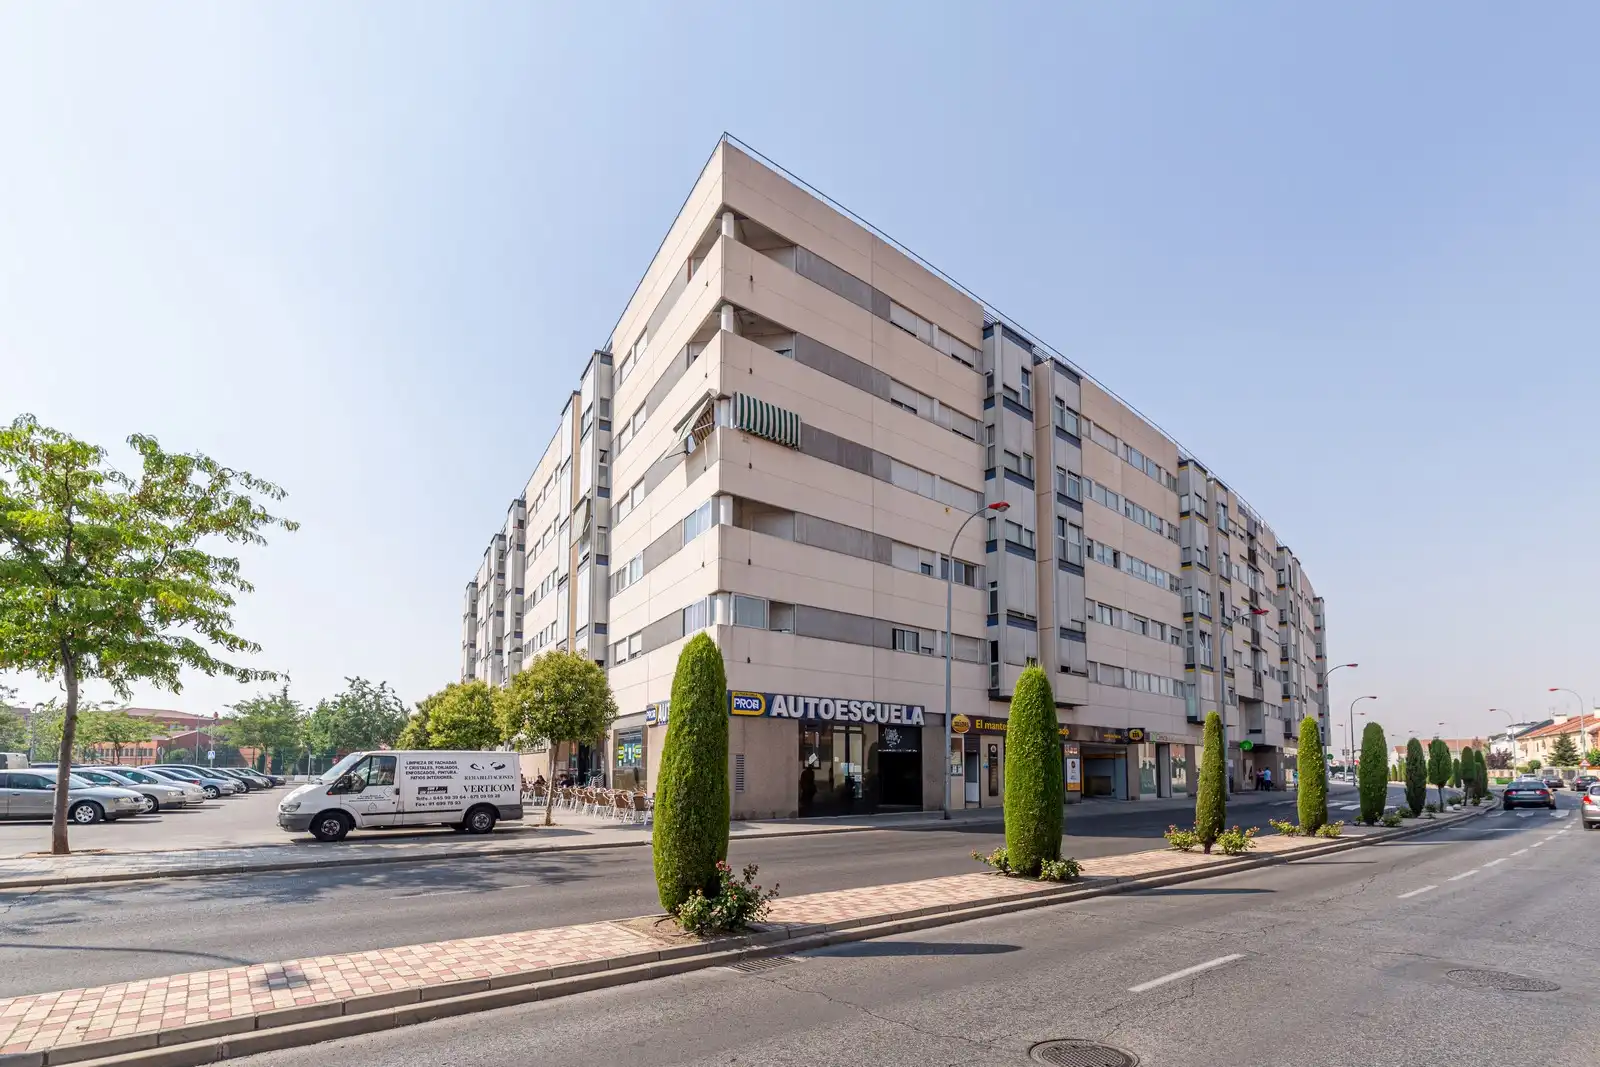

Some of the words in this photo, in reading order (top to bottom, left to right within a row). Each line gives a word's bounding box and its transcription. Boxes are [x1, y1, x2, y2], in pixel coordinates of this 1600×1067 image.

[770, 694, 925, 725] AUTOESCUELA
[976, 719, 983, 729] El
[463, 783, 515, 792] VERTICOM
